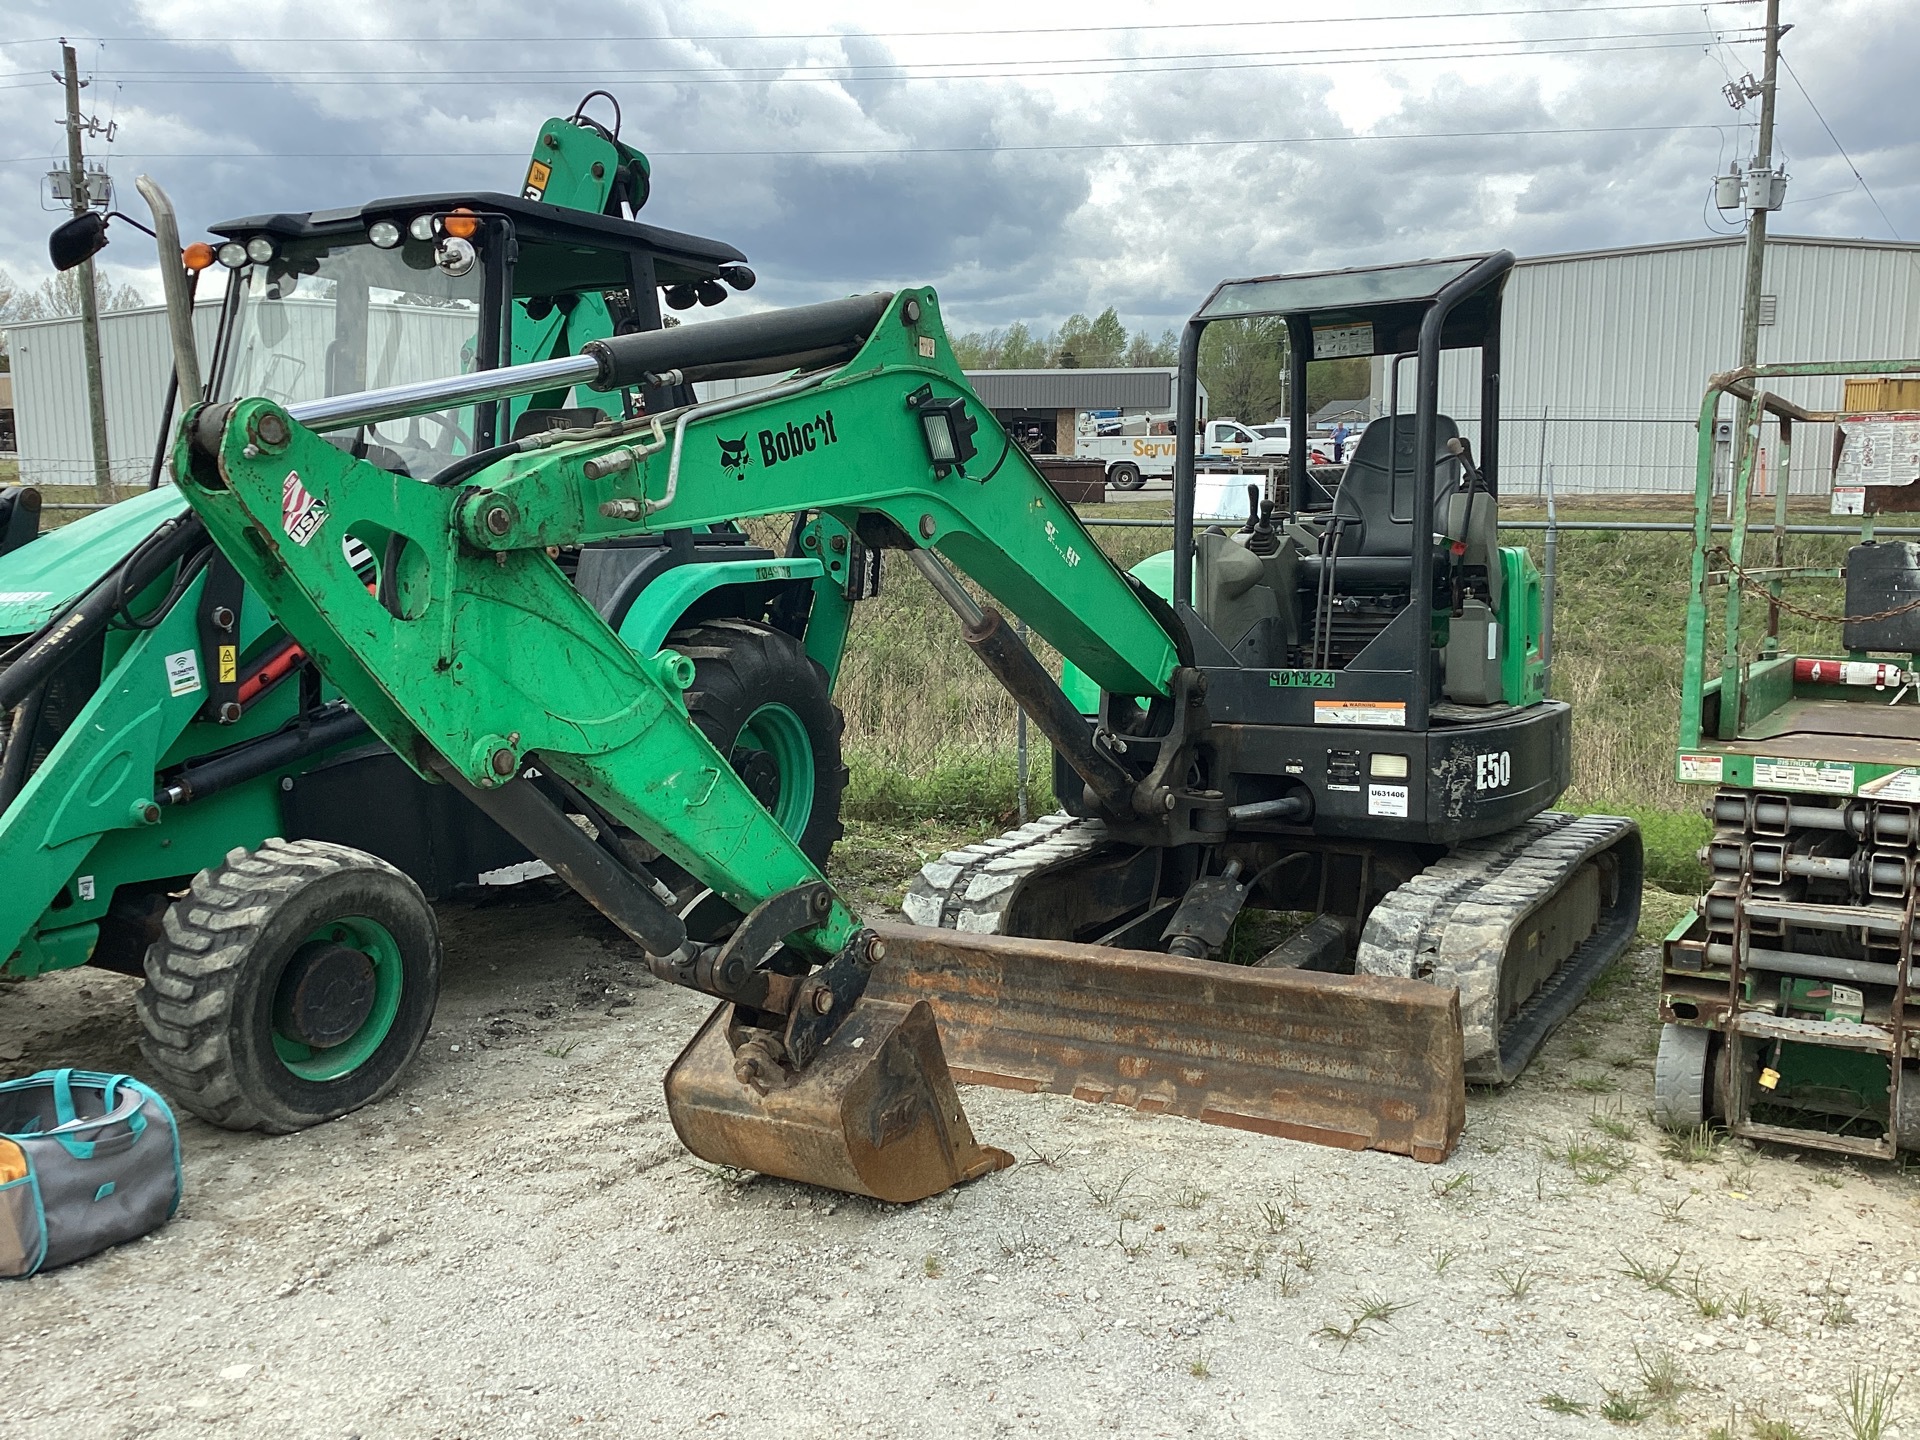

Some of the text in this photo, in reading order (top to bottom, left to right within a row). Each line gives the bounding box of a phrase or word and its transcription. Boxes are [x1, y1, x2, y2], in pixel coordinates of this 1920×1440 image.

[1133, 439, 1176, 457] Servi
[290, 505, 327, 543] USA
[1476, 751, 1511, 791] E50
[1371, 790, 1405, 798] U631406
